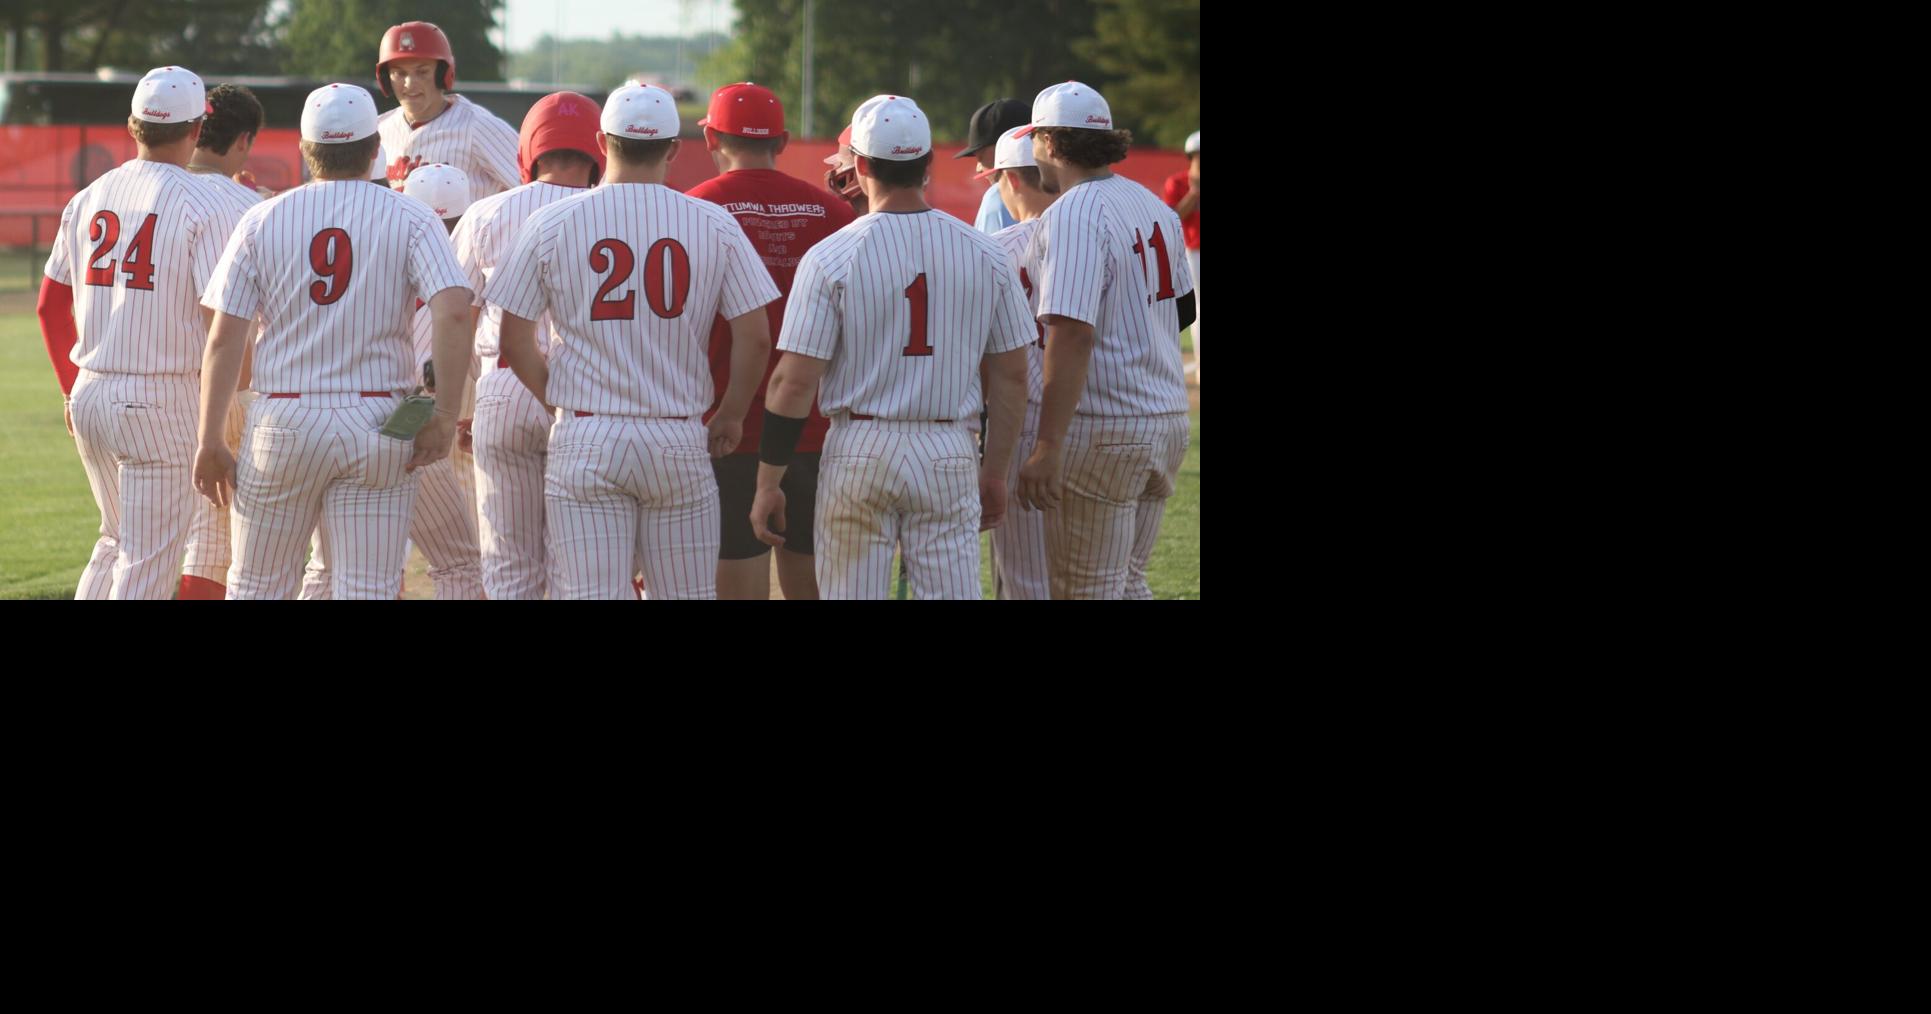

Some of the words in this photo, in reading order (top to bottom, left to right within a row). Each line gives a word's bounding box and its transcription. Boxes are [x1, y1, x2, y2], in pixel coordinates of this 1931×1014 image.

[143, 108, 171, 120] Bulldogs
[321, 131, 354, 141] Bulldogs
[625, 124, 658, 137] Bulldogs
[891, 145, 922, 156] Bulldogs
[721, 202, 766, 214] TTUMWA
[768, 204, 826, 216] THROWERS
[85, 209, 158, 291] 24
[308, 227, 353, 306] 9
[589, 237, 691, 321] 20
[902, 272, 934, 356] 1
